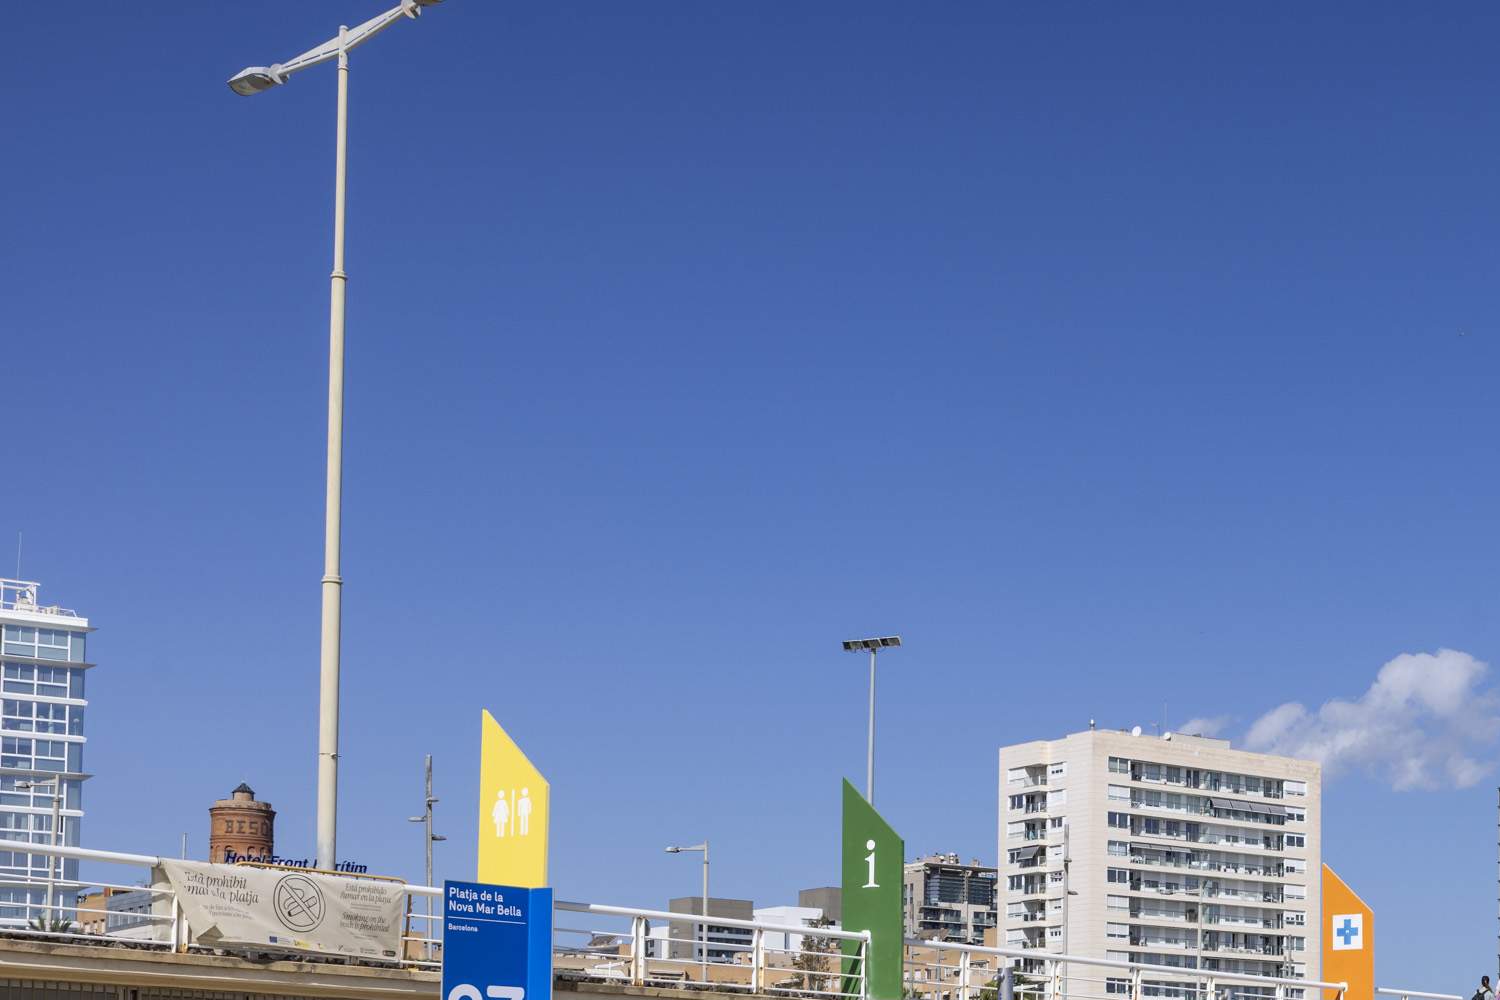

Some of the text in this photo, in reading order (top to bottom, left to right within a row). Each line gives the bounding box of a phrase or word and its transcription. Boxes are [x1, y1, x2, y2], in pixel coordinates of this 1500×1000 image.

[226, 852, 266, 864] Hotel
[270, 856, 309, 869] Front
[206, 875, 247, 889] prohibit
[229, 890, 260, 906] platja
[449, 887, 504, 903] Platja de la
[448, 900, 522, 917] Nova Mar Bella
[448, 923, 478, 932] Barcelona
